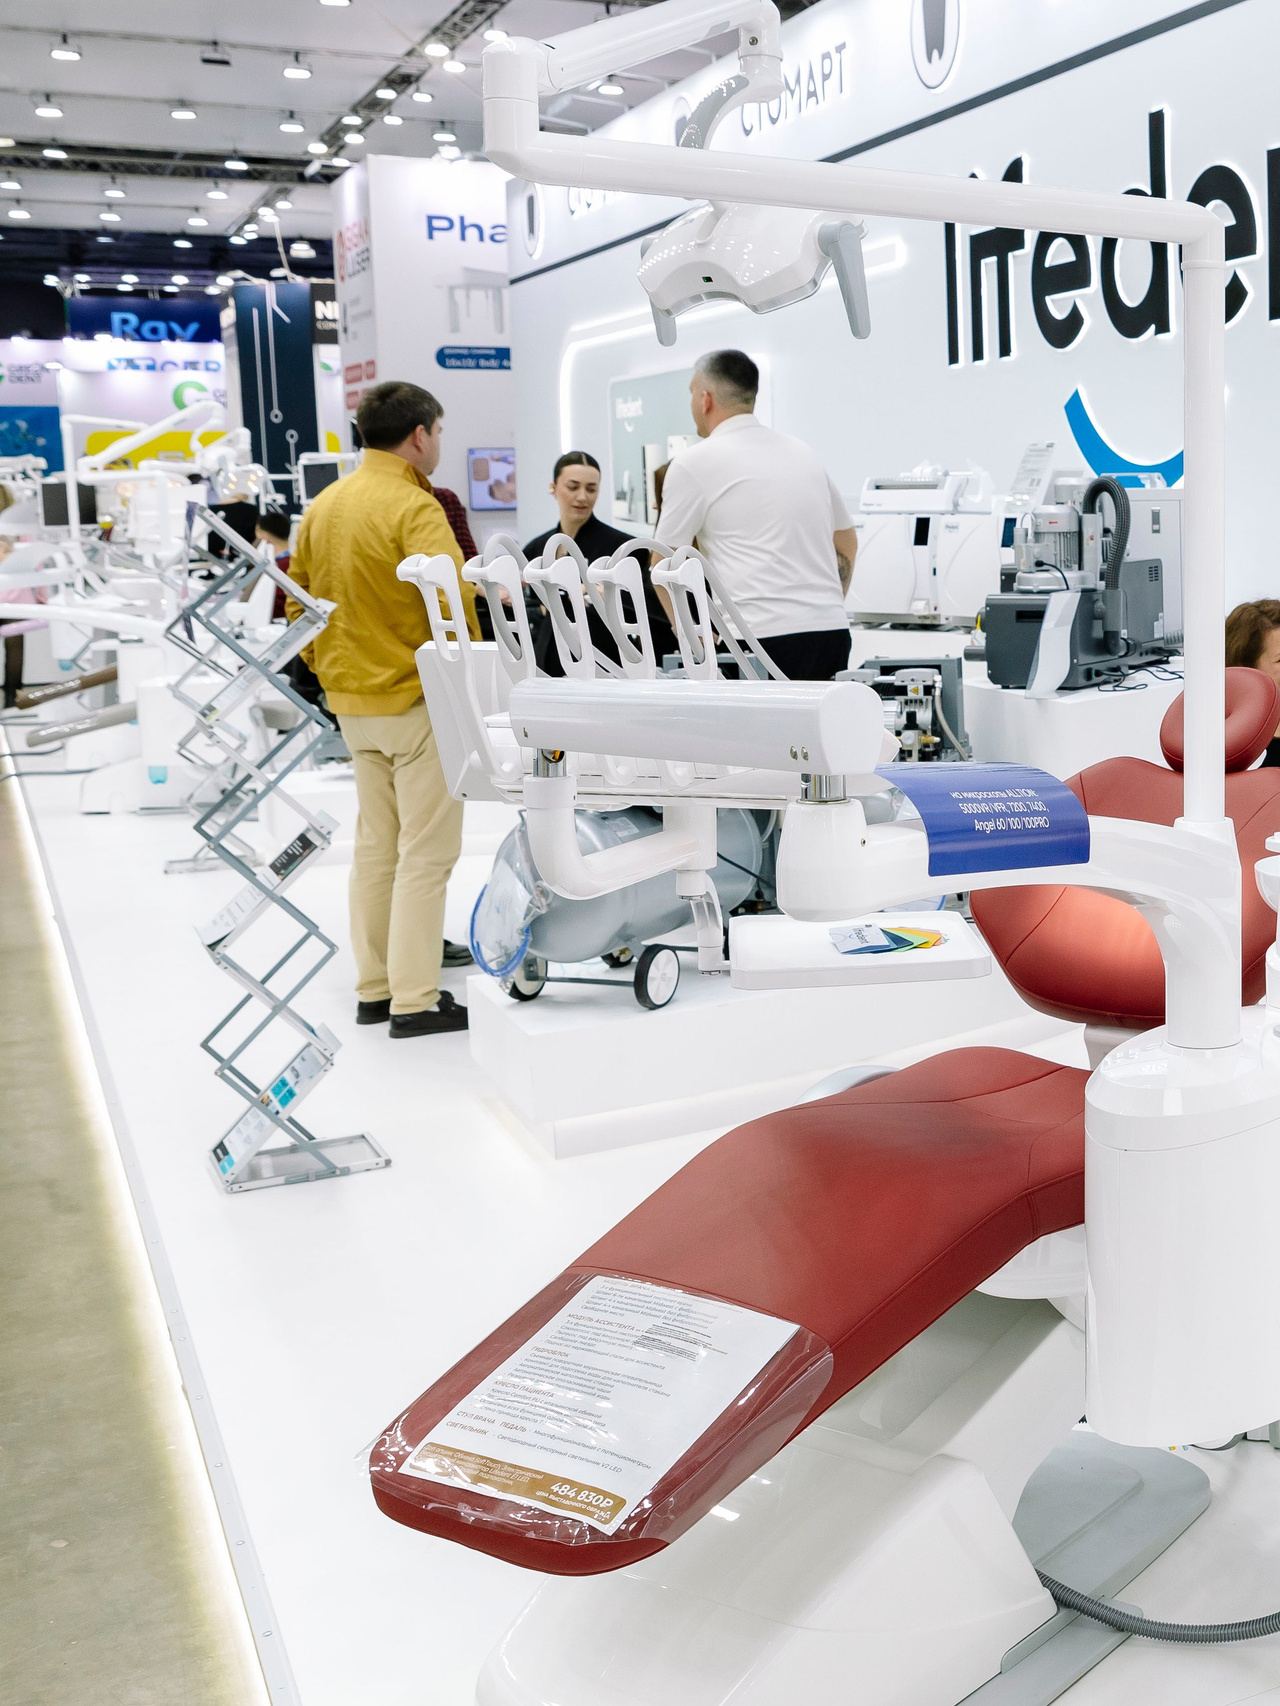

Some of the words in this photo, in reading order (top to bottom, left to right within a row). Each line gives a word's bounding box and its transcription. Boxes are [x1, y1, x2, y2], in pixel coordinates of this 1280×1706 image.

[110, 311, 200, 342] Ray
[974, 819, 996, 834] Angel
[996, 816, 1050, 832] 60/100/100PRO
[455, 1410, 475, 1419] СТУЛ
[472, 1414, 497, 1424] ВРАЧА
[445, 1419, 490, 1436] СВЕТИЛЬНИК
[498, 1421, 529, 1433] ПЕДАЛЬ
[550, 1482, 577, 1500] 484
